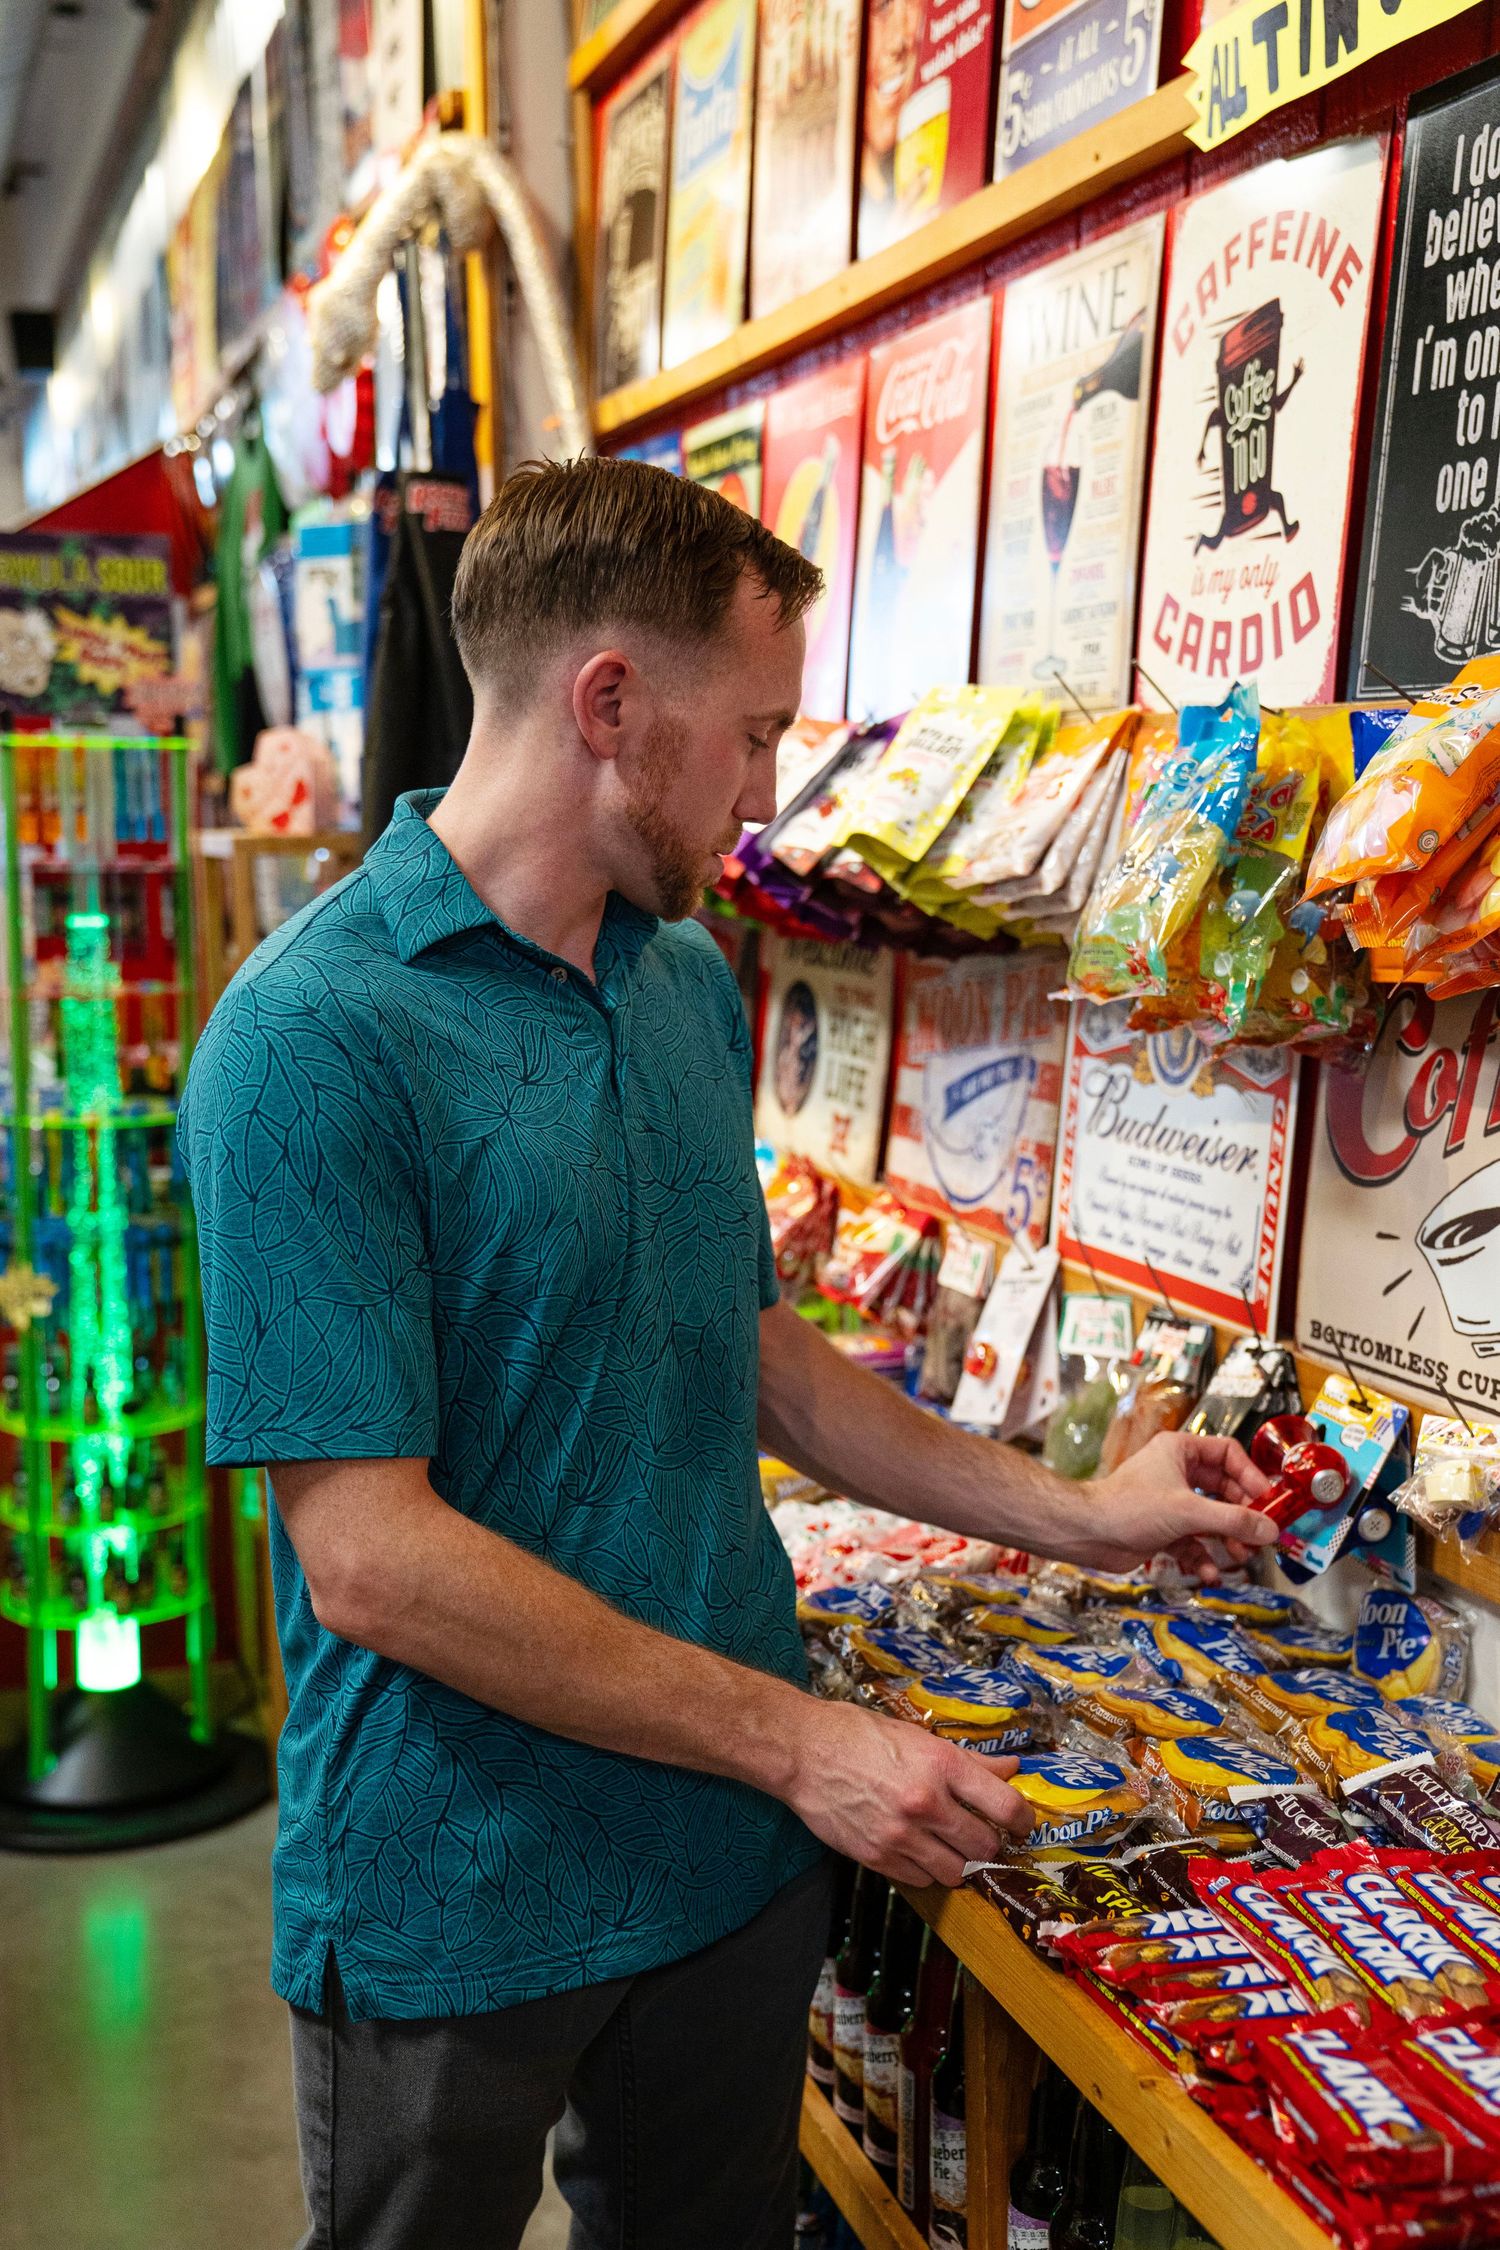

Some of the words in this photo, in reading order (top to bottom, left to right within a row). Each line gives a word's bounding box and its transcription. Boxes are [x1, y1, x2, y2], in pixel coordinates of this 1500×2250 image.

[1208, 37, 1248, 138] ALL
[1252, 0, 1359, 95] TIN
[1424, 187, 1500, 268] belie
[1020, 260, 1130, 368] WINE
[1172, 210, 1363, 359] CAFFEINE
[1223, 358, 1275, 427] Coffee
[1412, 325, 1457, 396] I'm
[1456, 389, 1484, 447] to
[1436, 457, 1488, 513] one
[1191, 566, 1205, 596] is
[1207, 570, 1236, 604] my
[1239, 554, 1279, 600] only
[1154, 571, 1321, 678] CARDIO
[1083, 1067, 1259, 1177] Budweiser
[1255, 1098, 1287, 1306] GENUINE
[1309, 1318, 1449, 1389] BOTTOMLESS
[1198, 1637, 1253, 1673] Pie
[1376, 1627, 1417, 1661] Pie
[1000, 1727, 1033, 1748] Pie
[1250, 1688, 1289, 1720] Caramel
[1026, 1818, 1086, 1847] Moon
[1086, 1806, 1125, 1835] Pie
[1231, 1884, 1360, 1981] CLARK
[1302, 1889, 1434, 1985] CLARK
[1344, 1871, 1478, 1982] CLARK
[1284, 2027, 1424, 2131] CLARK
